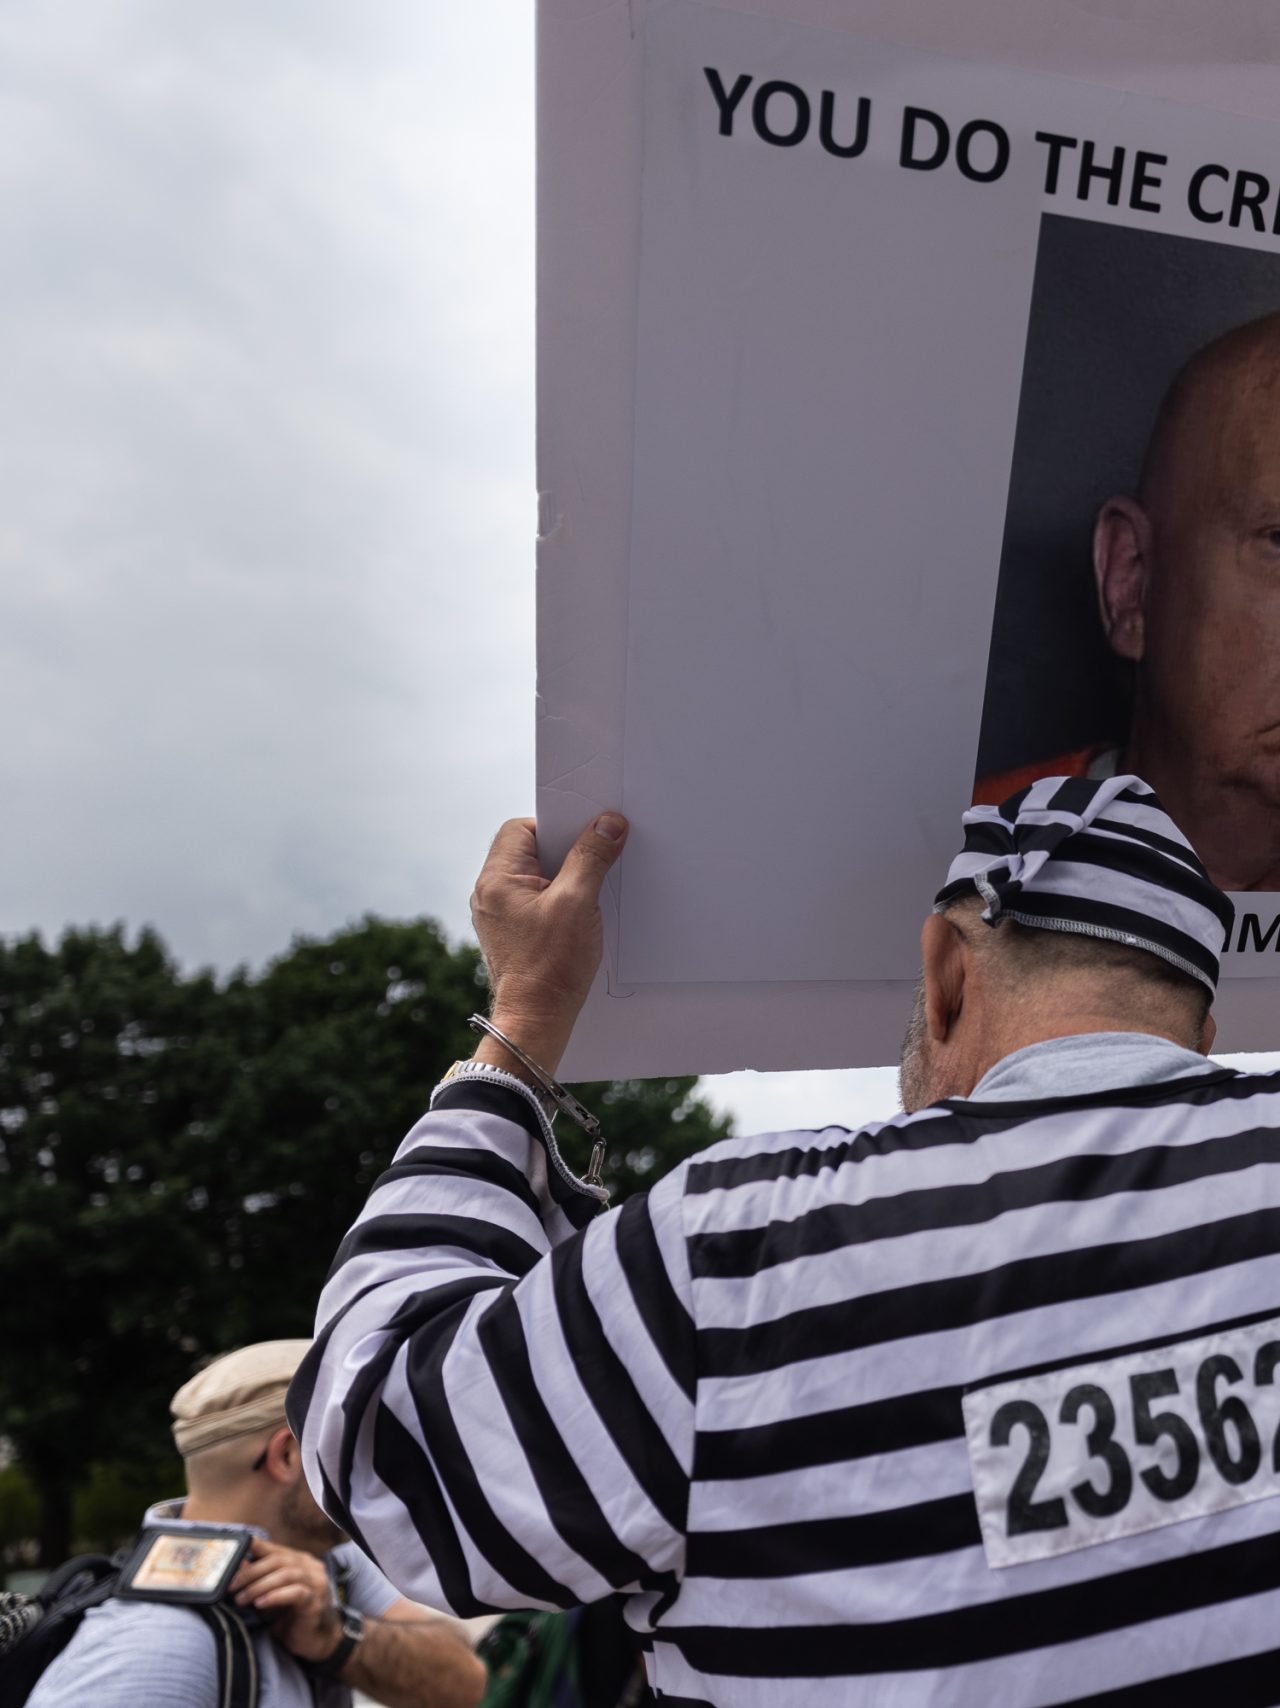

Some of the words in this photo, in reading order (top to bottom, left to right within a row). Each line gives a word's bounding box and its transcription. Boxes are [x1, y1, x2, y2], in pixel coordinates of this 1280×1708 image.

[703, 66, 872, 159] YOU
[899, 105, 1011, 184] DO
[1034, 130, 1168, 214] THE
